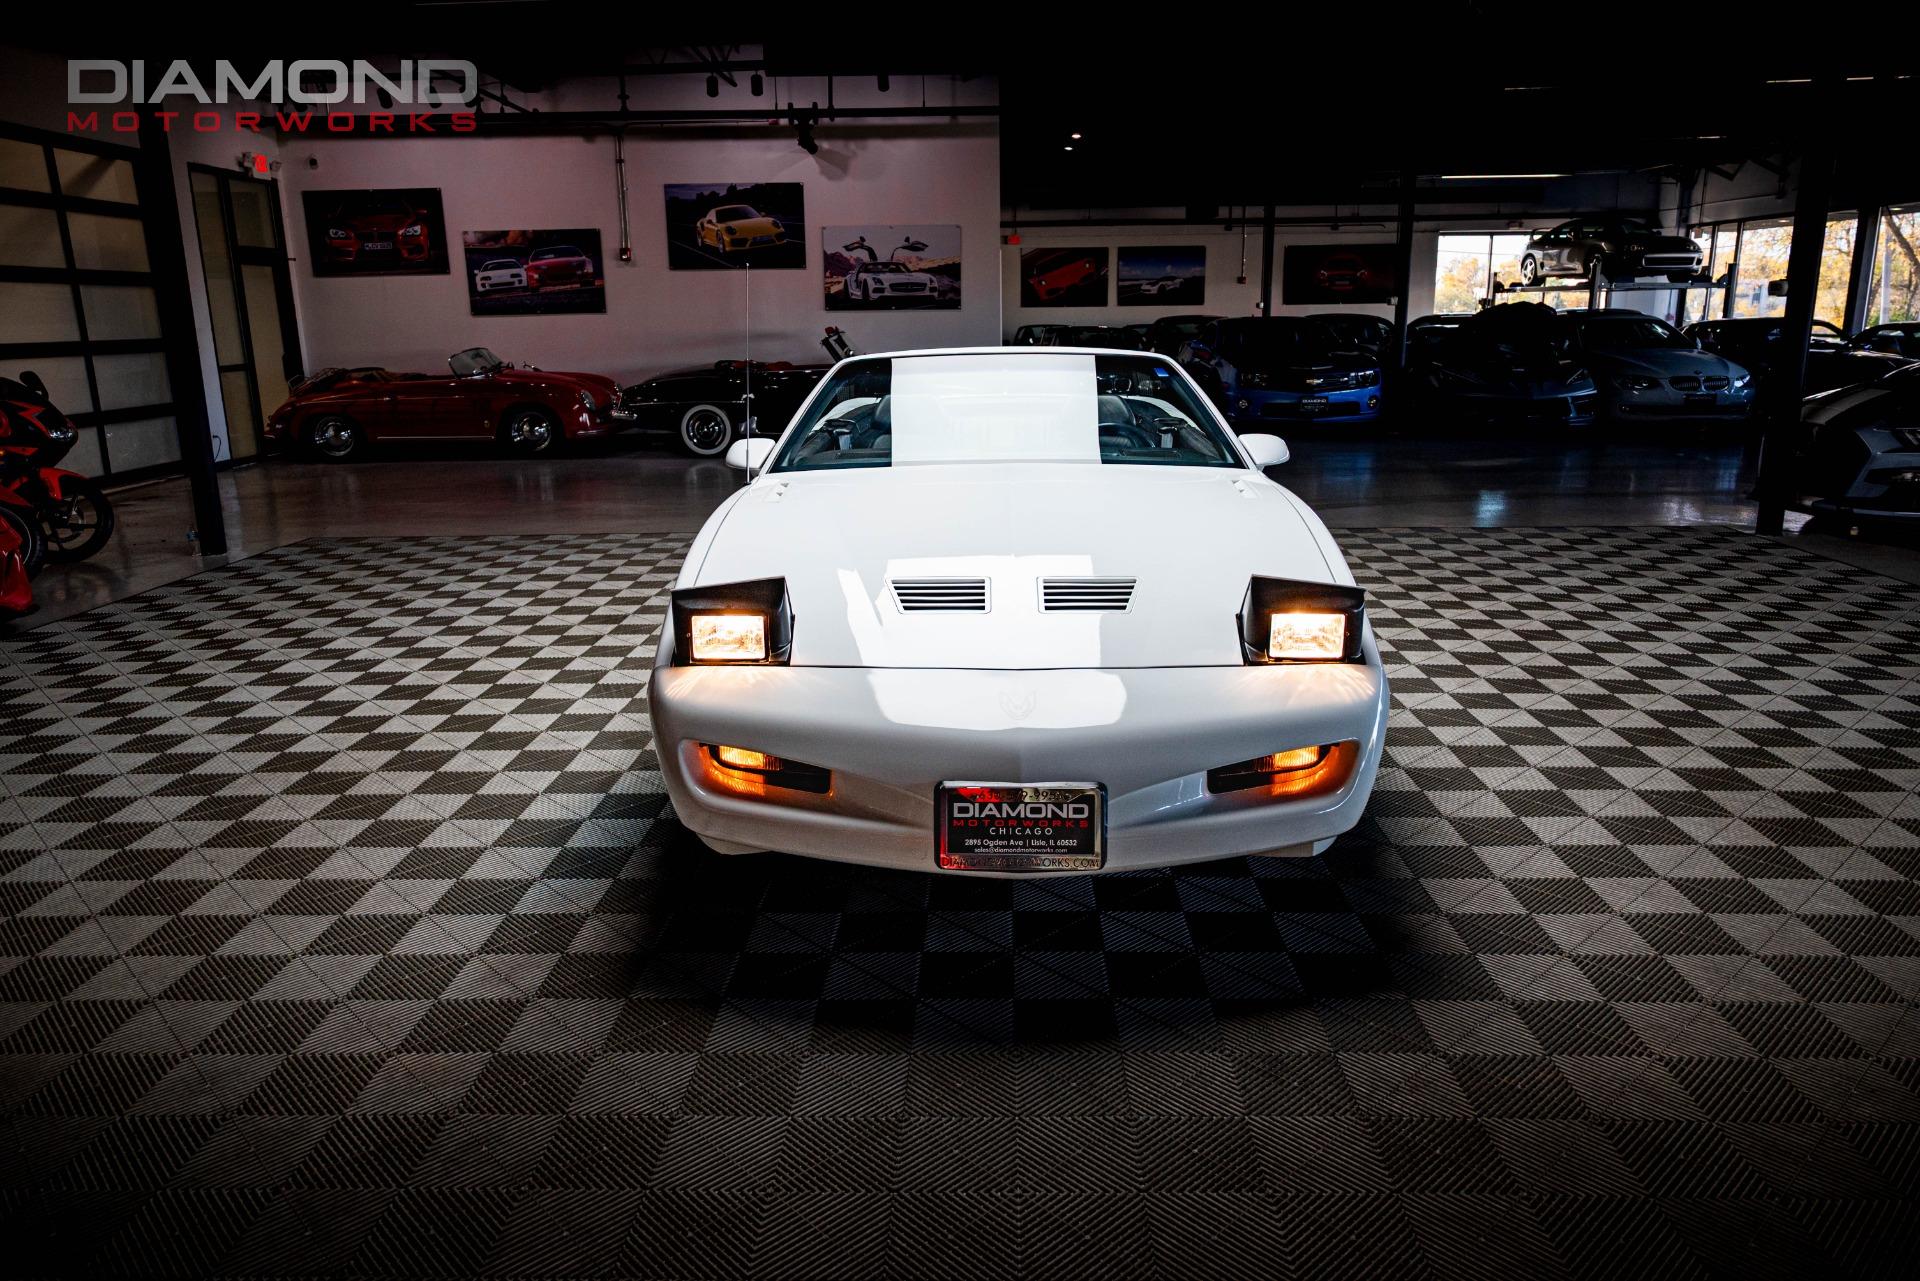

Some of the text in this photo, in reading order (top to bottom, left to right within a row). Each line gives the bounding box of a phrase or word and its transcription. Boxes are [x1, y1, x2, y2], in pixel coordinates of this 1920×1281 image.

[953, 803, 1089, 818] DIAMOND
[952, 819, 1089, 828] MOTORWORKS
[989, 827, 1054, 836] CHICAGO
[984, 839, 1008, 848] Ogden
